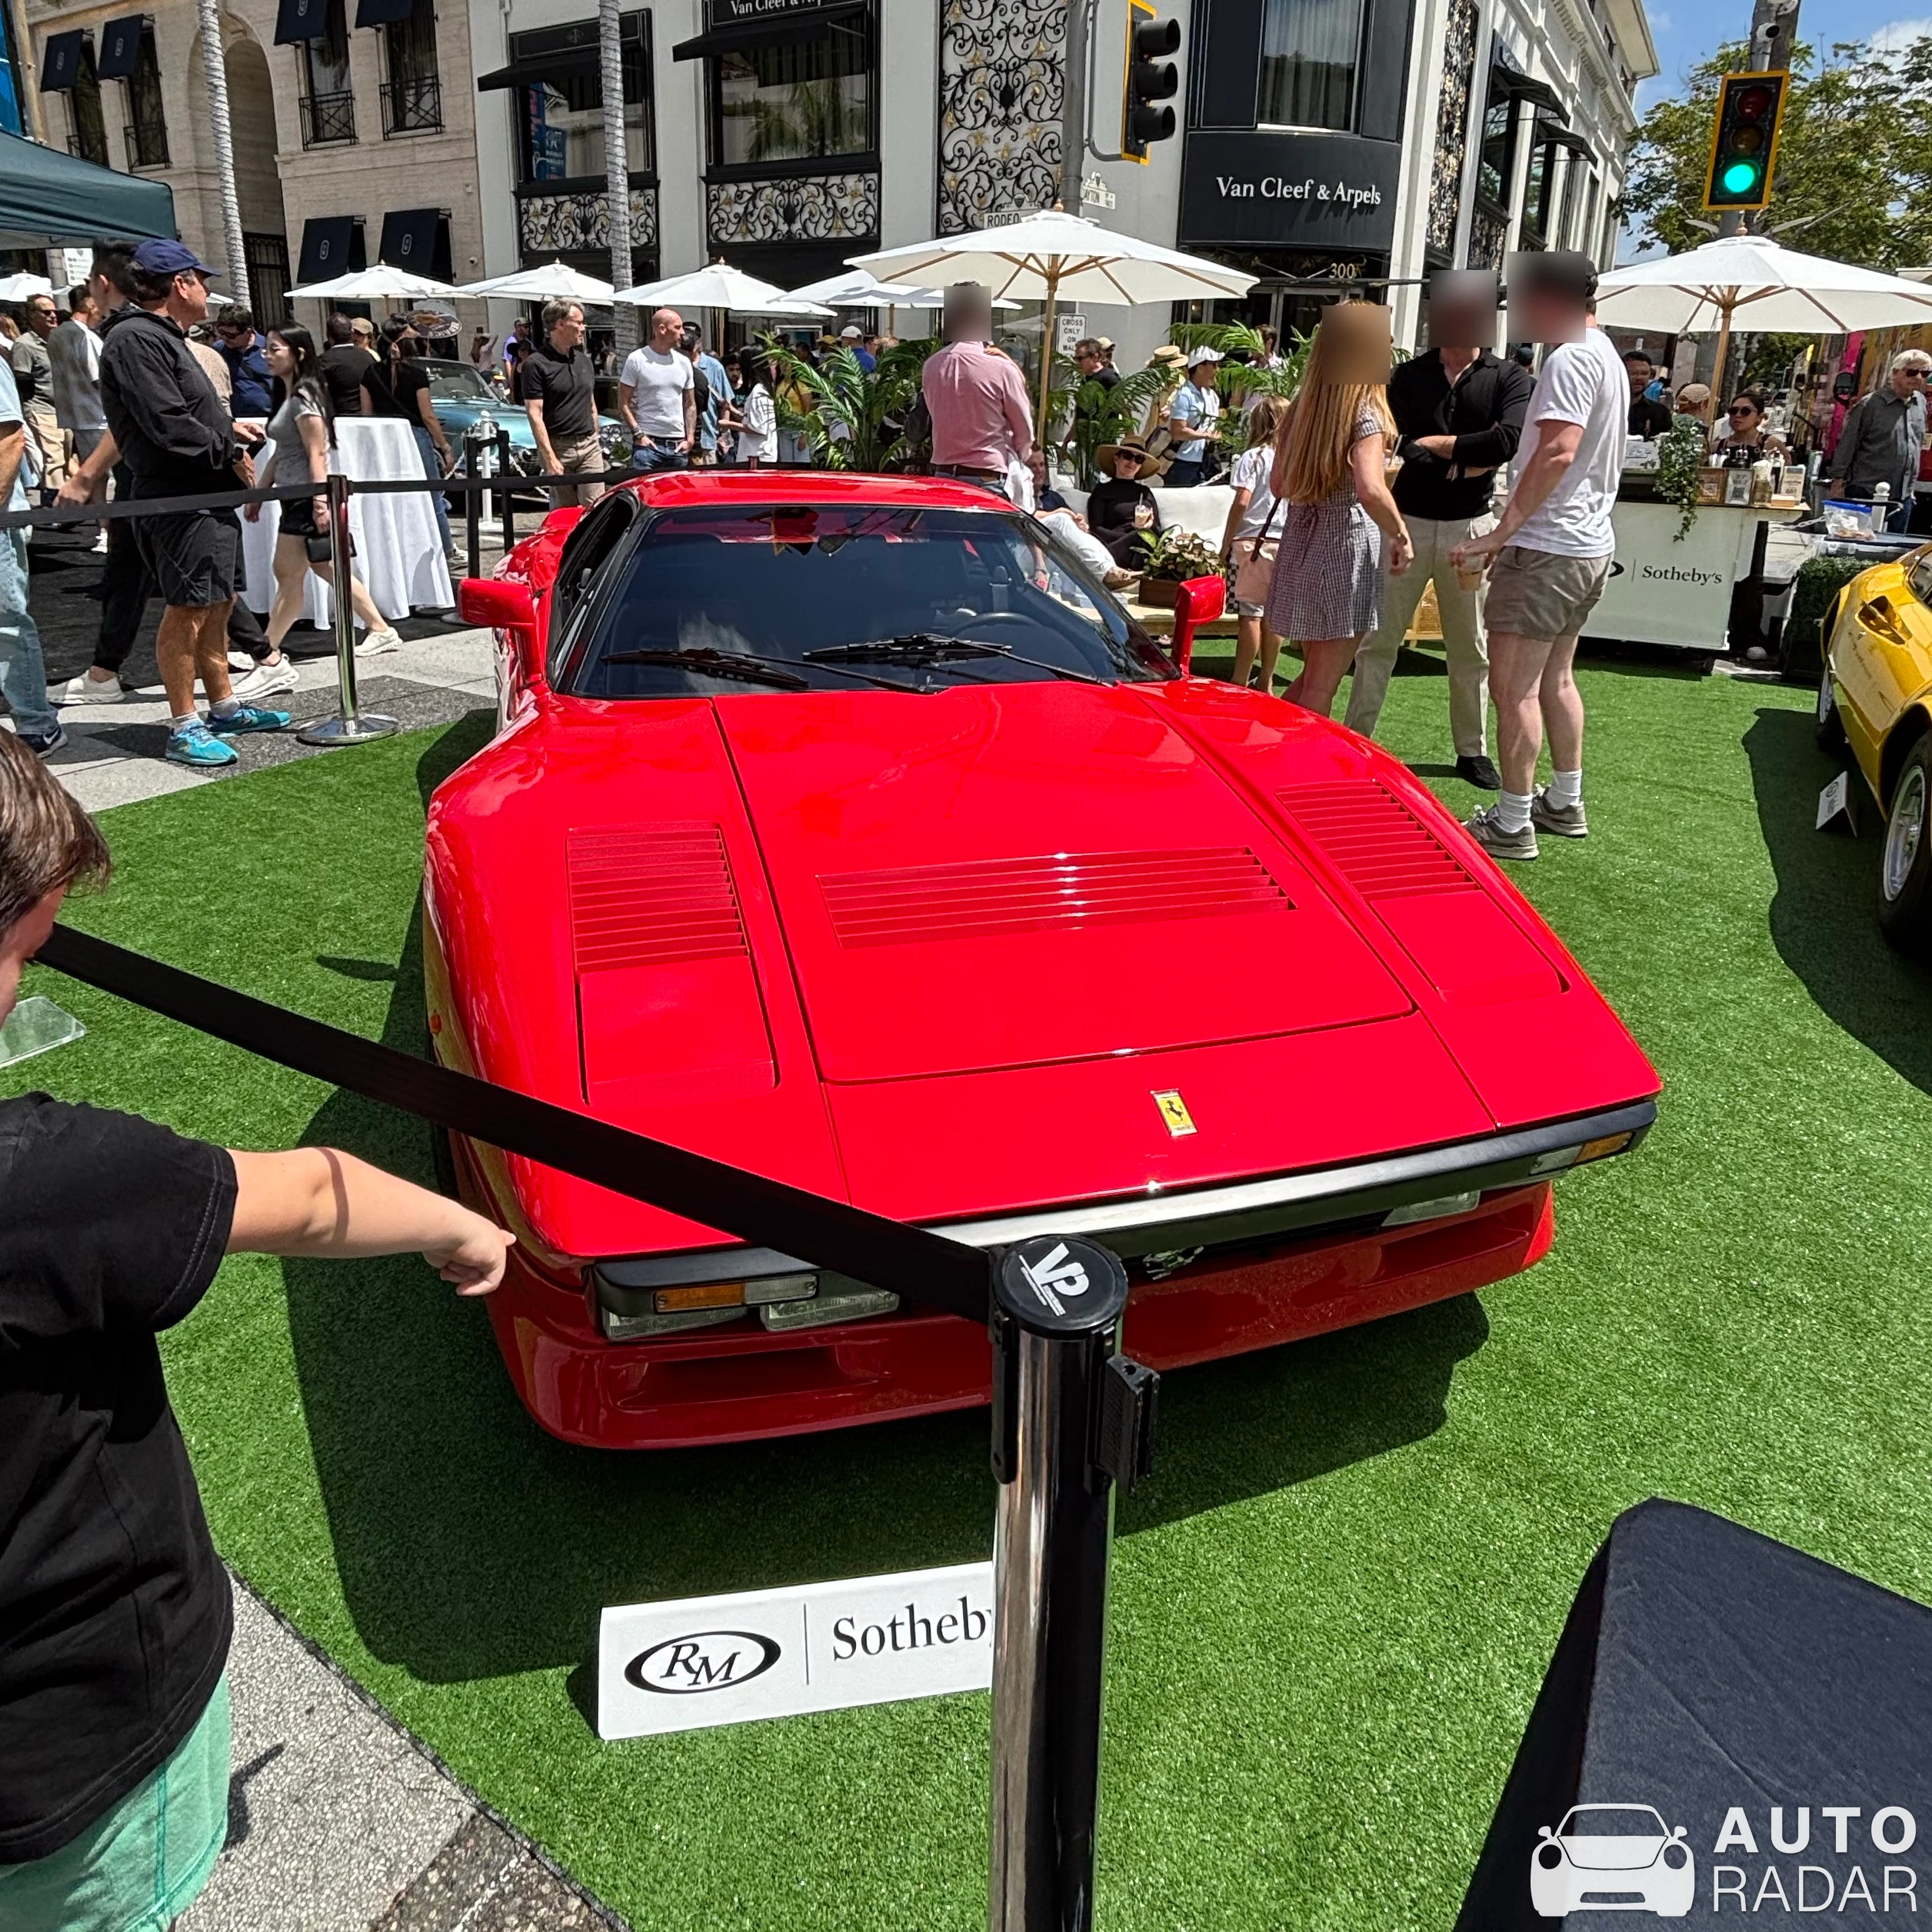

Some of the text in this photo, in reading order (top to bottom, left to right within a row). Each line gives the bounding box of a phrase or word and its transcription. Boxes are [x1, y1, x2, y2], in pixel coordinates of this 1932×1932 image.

[731, 0, 753, 15] Van
[1216, 176, 1381, 208] Van Cleef & Arpels
[987, 212, 1020, 228] RODEO
[1329, 262, 1355, 278] 300
[1061, 318, 1083, 327] CROSS
[1642, 565, 1723, 586] Sotheby's
[659, 1596, 992, 1687] RM Sotheb
